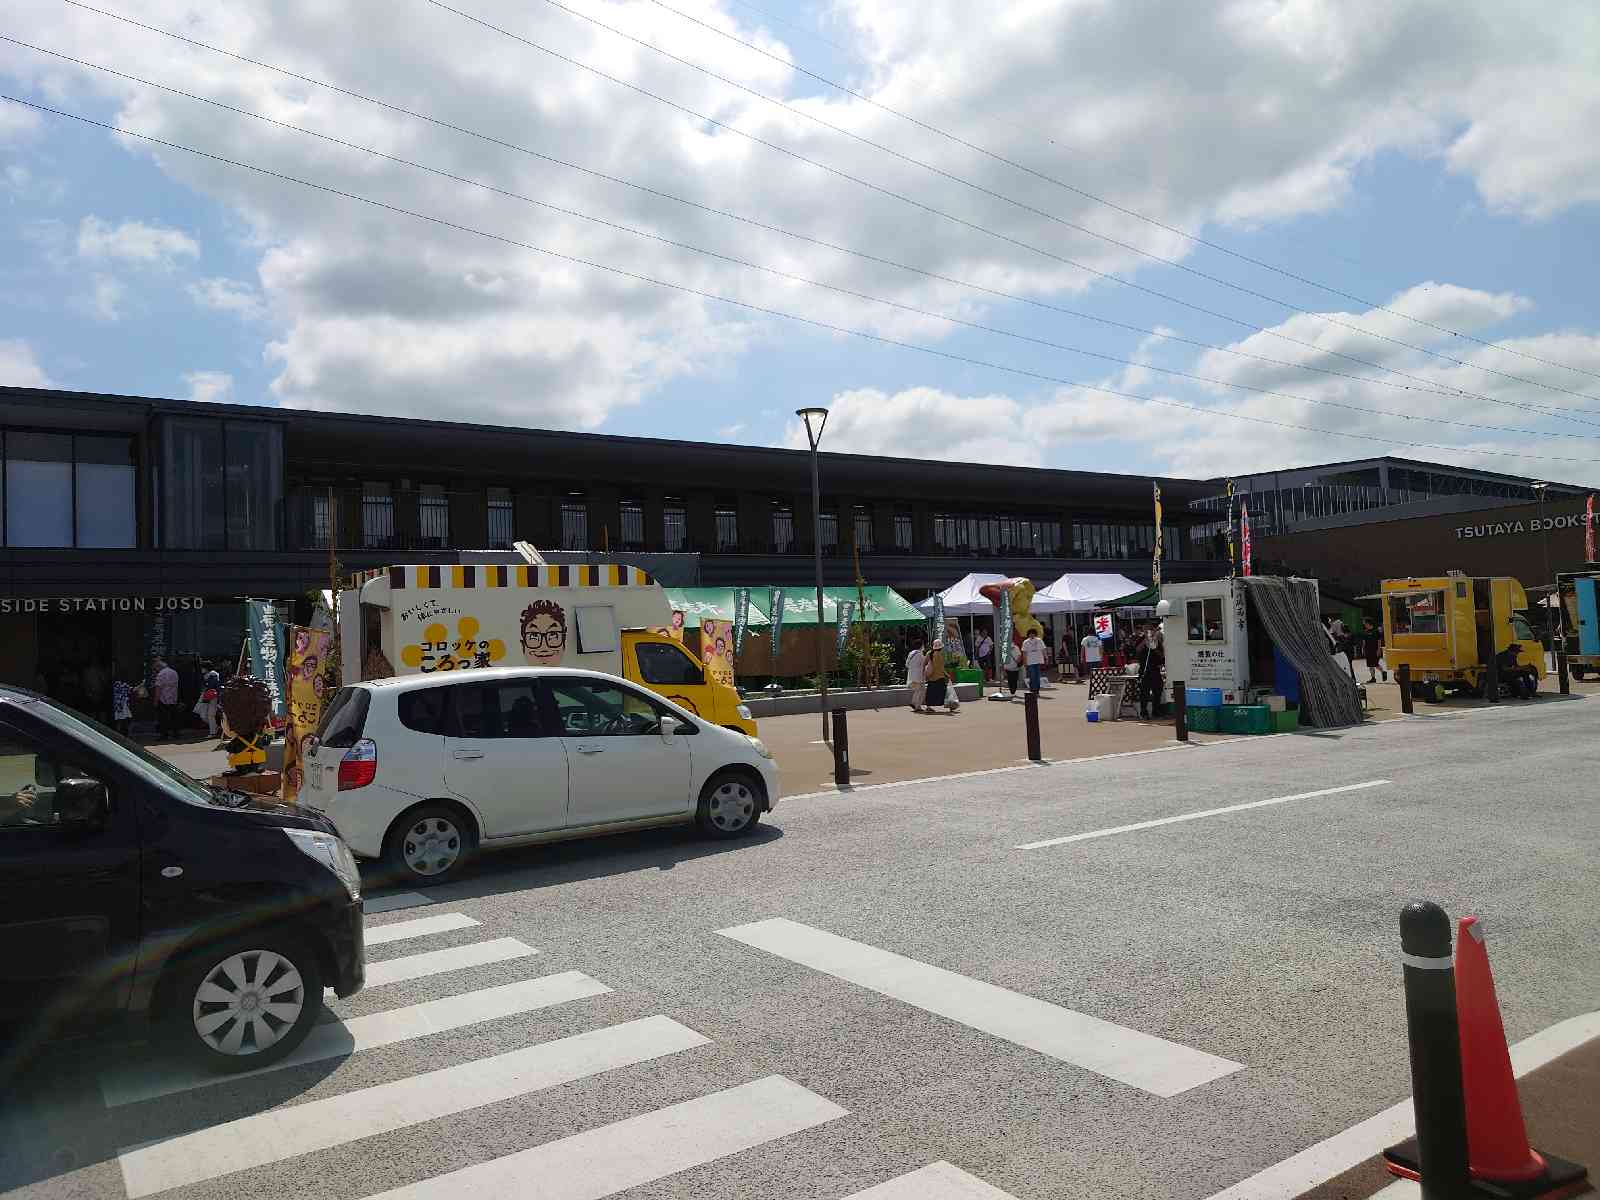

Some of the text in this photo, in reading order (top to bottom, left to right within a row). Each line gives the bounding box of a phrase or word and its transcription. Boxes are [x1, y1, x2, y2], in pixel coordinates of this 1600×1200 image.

[1456, 521, 1524, 539] TSUTAYA
[0, 599, 48, 613] SIDE
[59, 598, 146, 612] STATION
[420, 640, 490, 652] コロッケの
